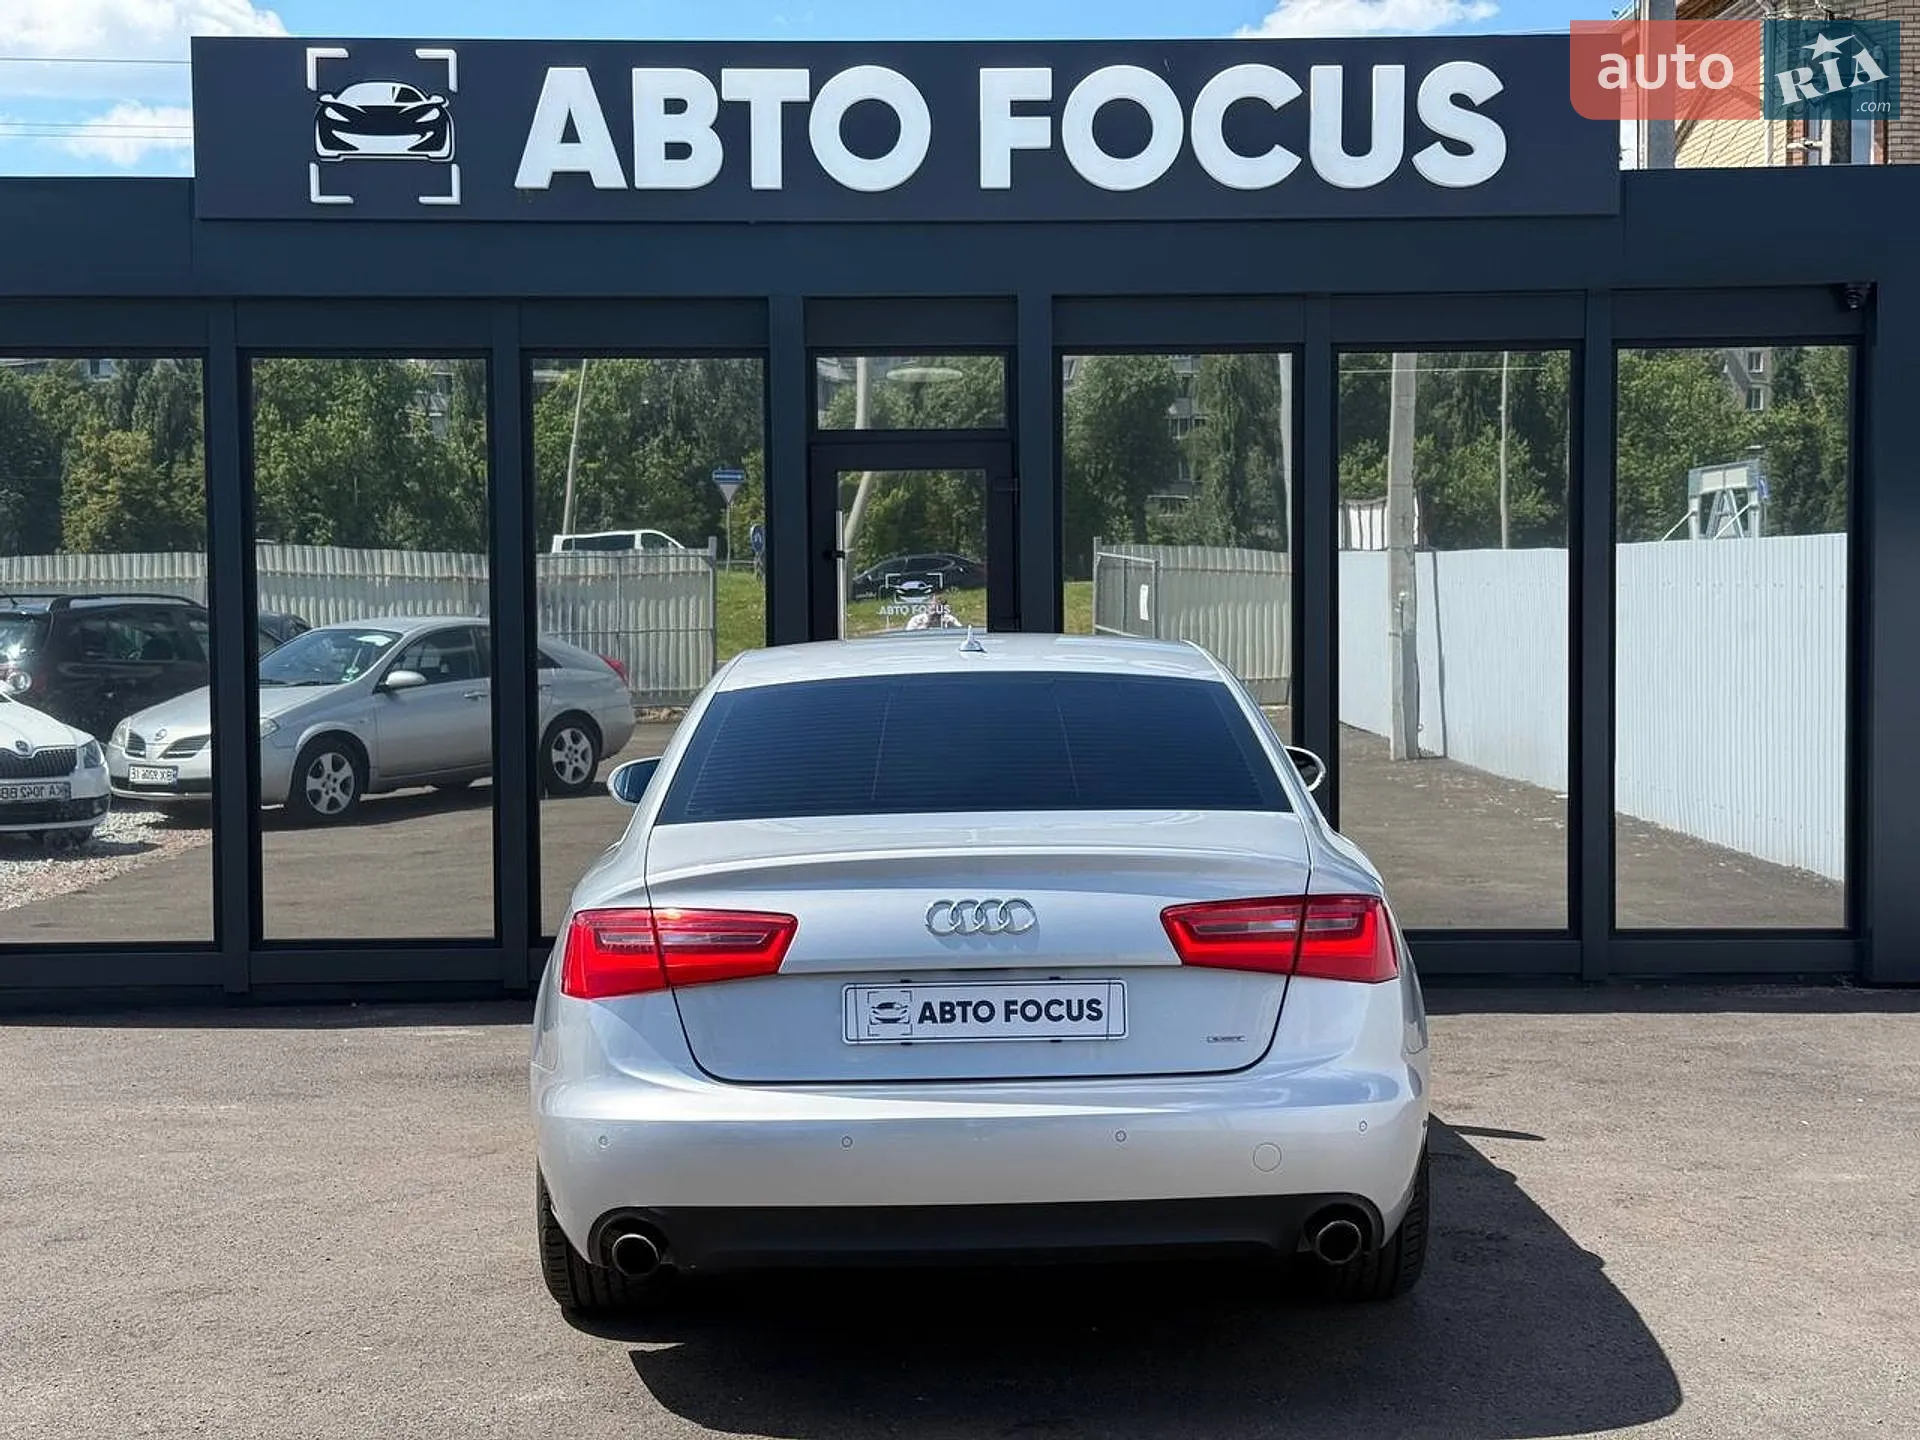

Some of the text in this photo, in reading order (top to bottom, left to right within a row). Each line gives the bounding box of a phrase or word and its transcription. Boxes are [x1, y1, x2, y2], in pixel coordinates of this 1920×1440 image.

[514, 60, 1507, 192] АВТО FOCUS
[917, 998, 1104, 1025] АВТО FOCUS
